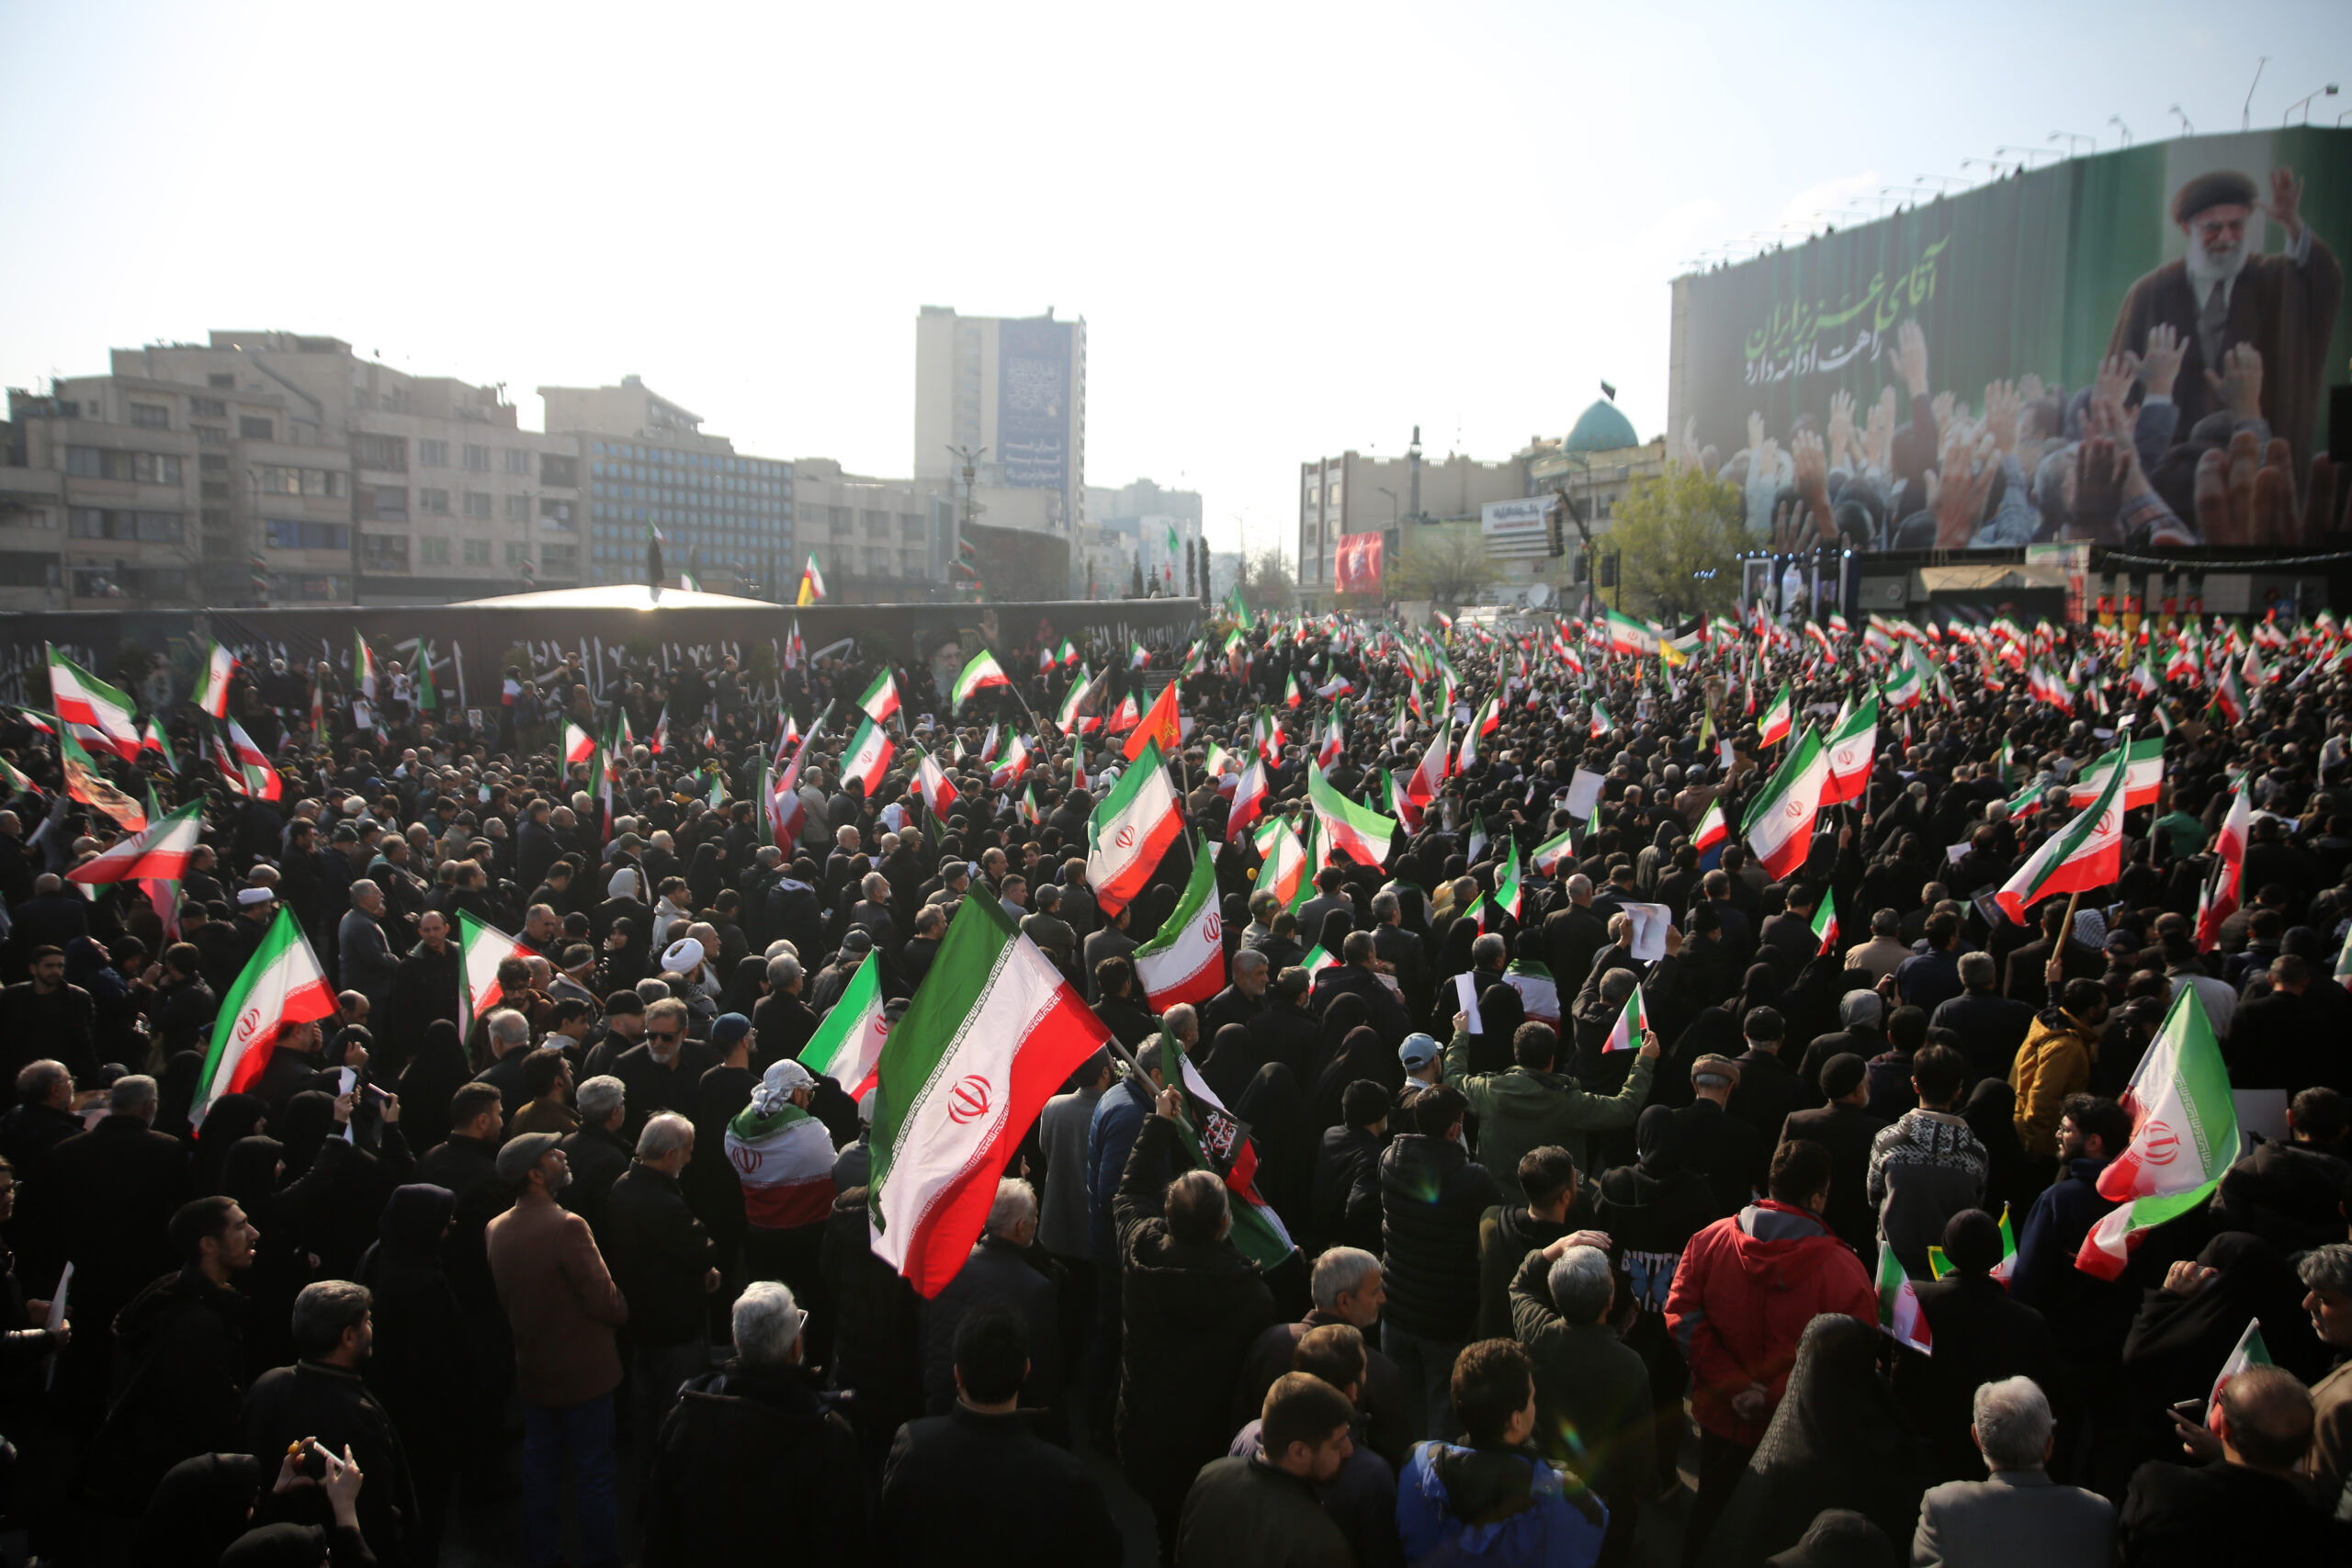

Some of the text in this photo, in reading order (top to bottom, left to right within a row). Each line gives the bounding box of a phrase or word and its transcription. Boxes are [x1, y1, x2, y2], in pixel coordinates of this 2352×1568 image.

[1745, 233, 1950, 359] آقای عزیز ایران
[1745, 327, 1883, 386] راهت ادامه دارد
